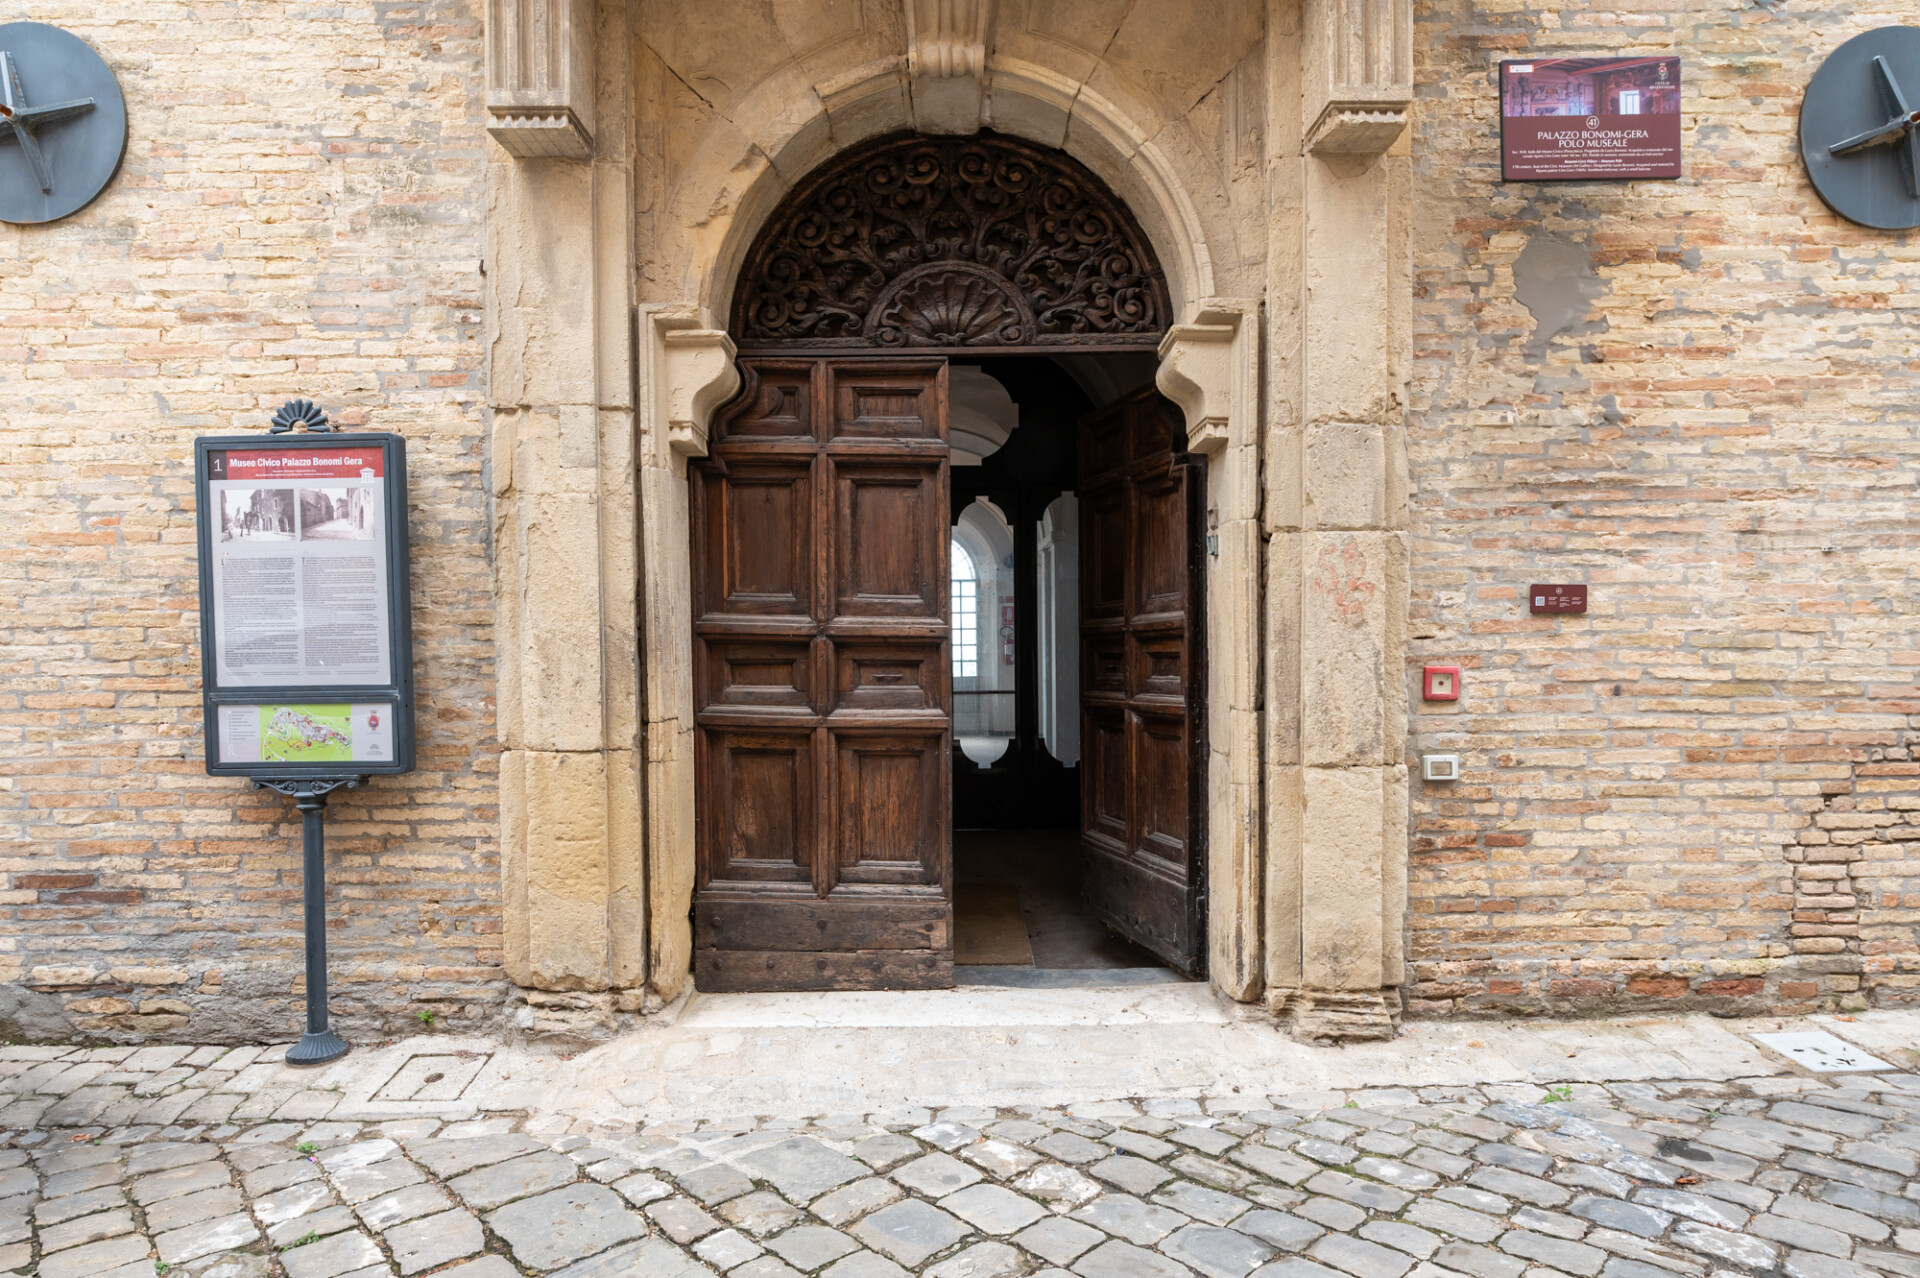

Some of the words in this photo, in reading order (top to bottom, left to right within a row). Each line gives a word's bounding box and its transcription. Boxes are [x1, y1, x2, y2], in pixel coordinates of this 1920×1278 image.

[1588, 118, 1597, 127] 41
[1537, 131, 1579, 140] PALAZZO
[1581, 130, 1648, 139] BONOMI-GERA
[1558, 139, 1584, 148] POLO
[1586, 138, 1628, 147] MUSEALE
[213, 458, 223, 472] 1
[229, 458, 256, 468] Museo
[257, 458, 281, 467] Civico
[282, 457, 312, 467] Palazzo
[313, 456, 342, 466] Bonomi
[344, 456, 363, 466] Gera
